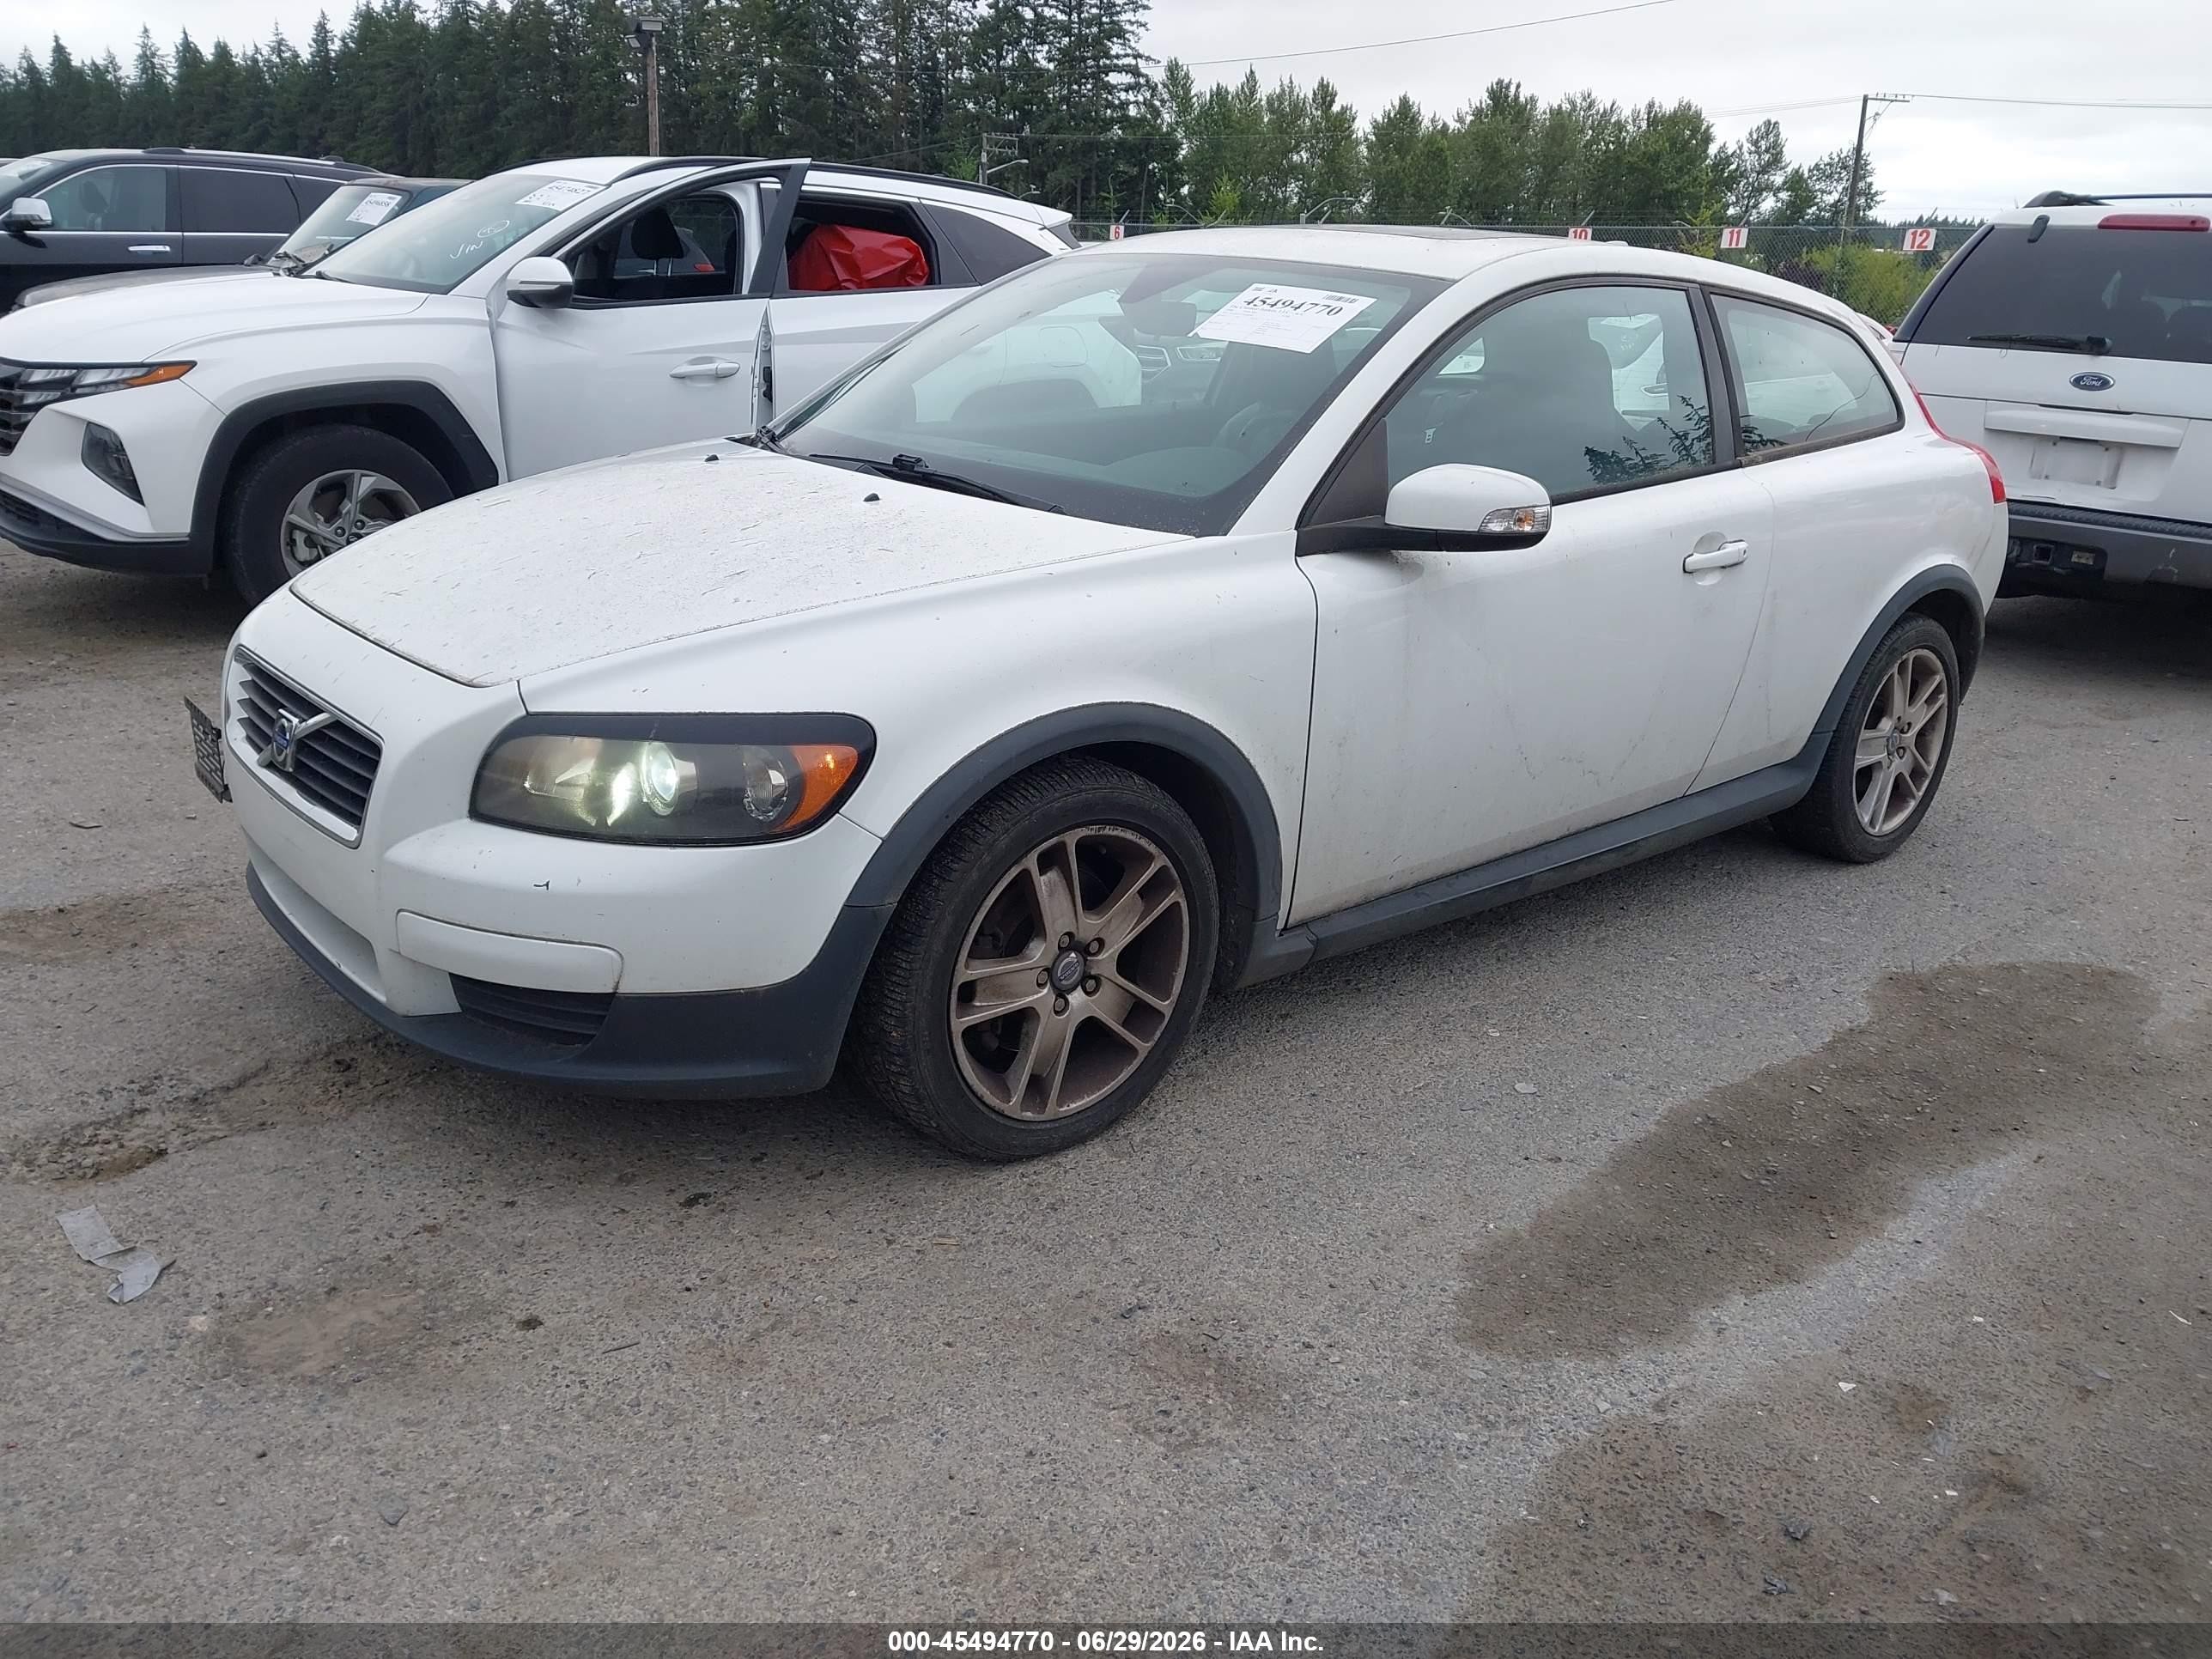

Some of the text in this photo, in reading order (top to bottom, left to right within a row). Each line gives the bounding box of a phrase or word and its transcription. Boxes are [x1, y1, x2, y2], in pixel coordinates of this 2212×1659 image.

[1114, 226, 1121, 240] 6
[1572, 228, 1588, 240] 10
[1728, 228, 1741, 246] 11
[1910, 229, 1931, 249] 12
[1243, 295, 1344, 317] 45494770
[2080, 376, 2103, 386] Ford
